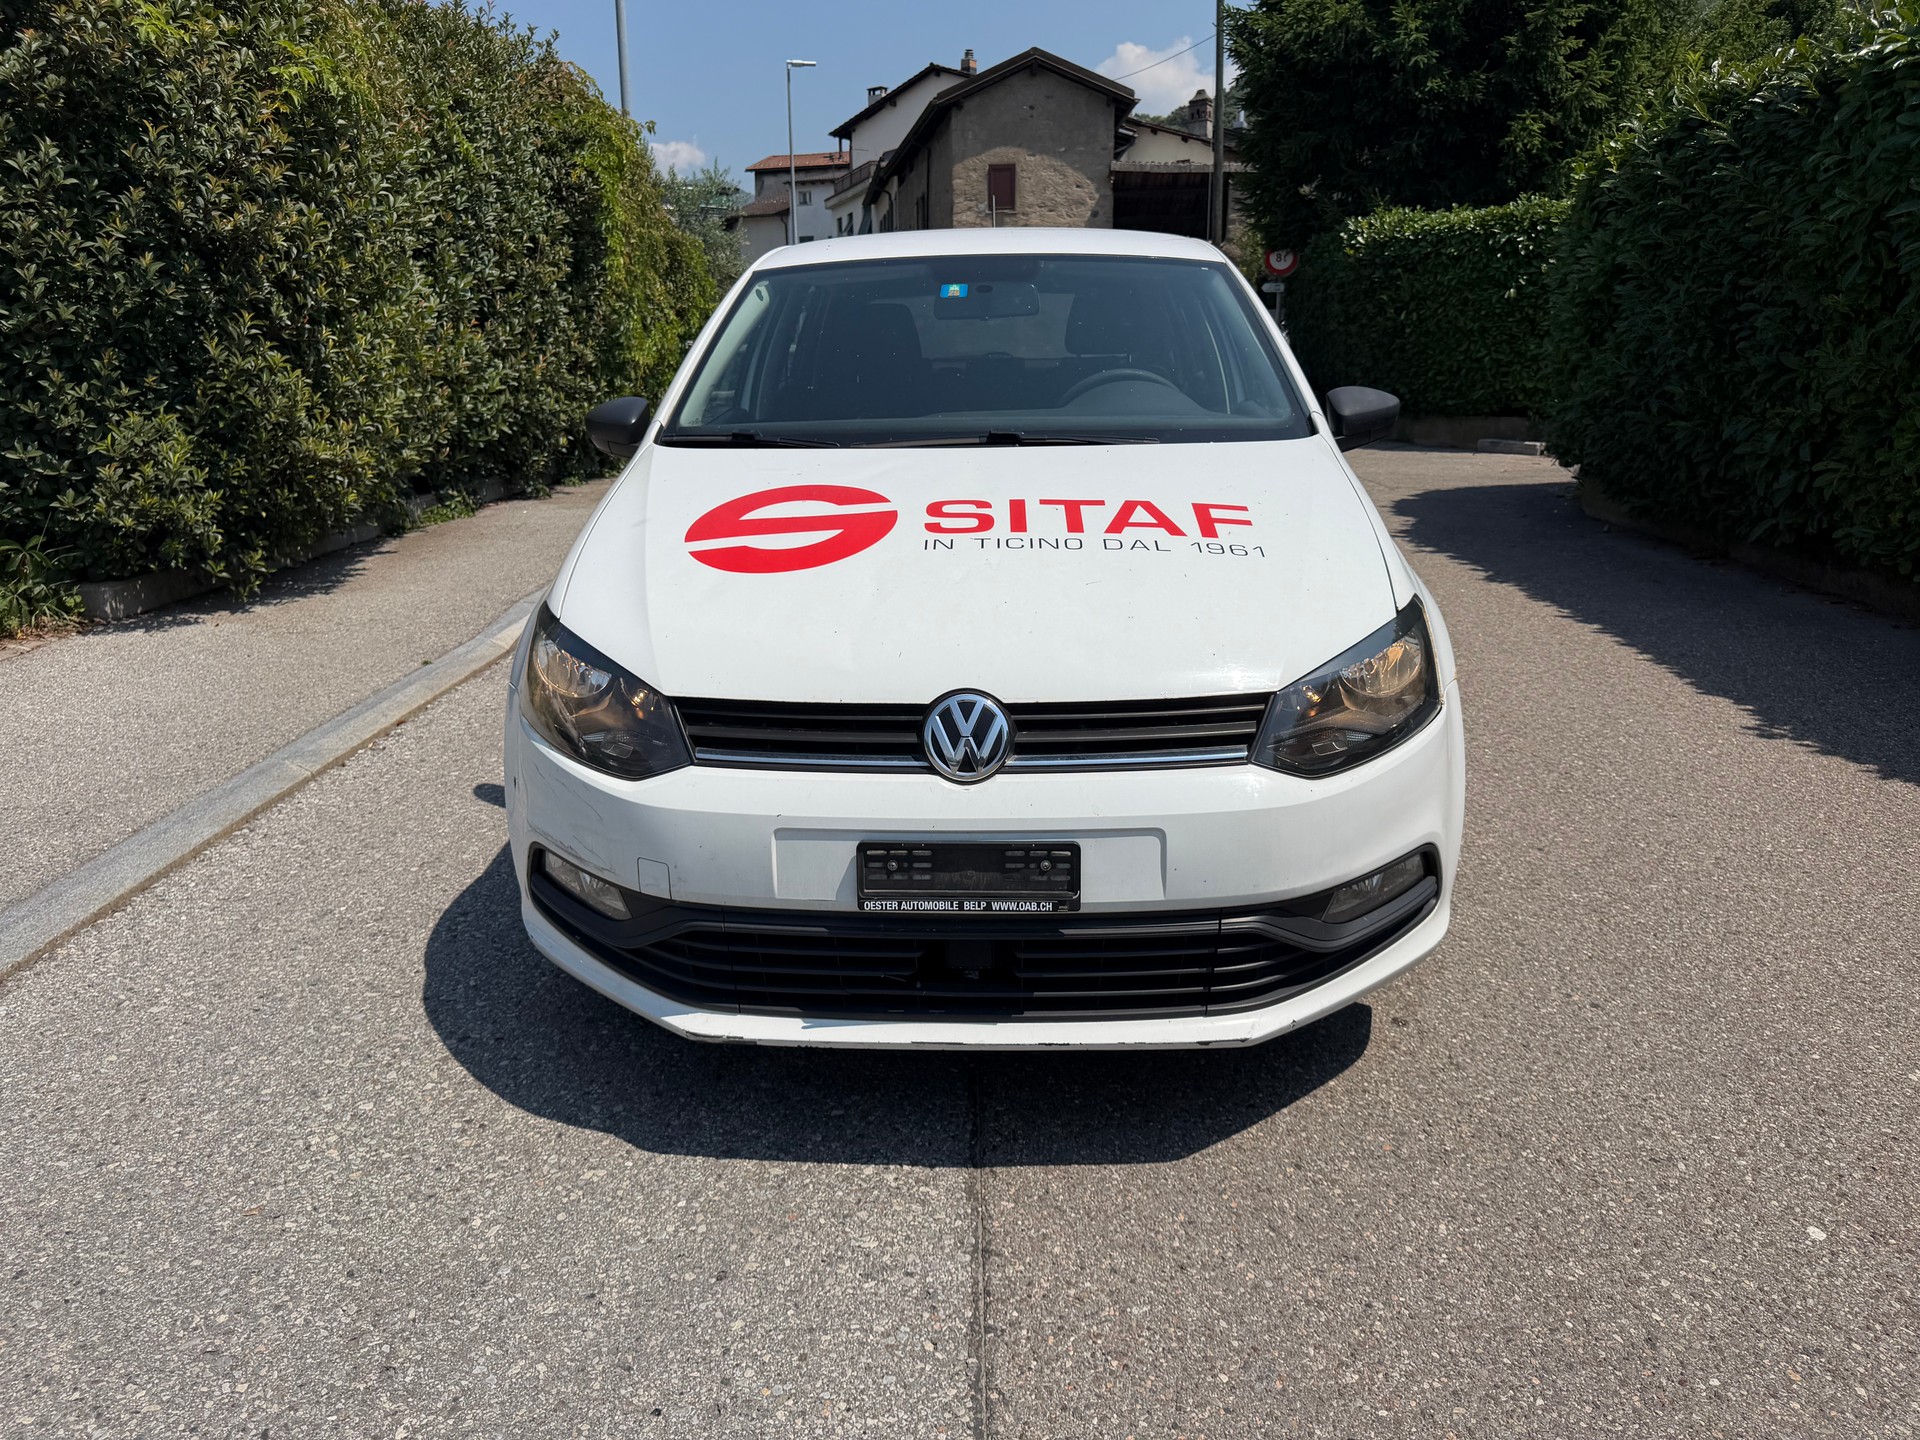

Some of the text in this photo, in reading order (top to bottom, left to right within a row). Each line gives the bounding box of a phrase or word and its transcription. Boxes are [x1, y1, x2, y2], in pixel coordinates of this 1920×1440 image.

[924, 499, 1253, 538] SITAF
[924, 537, 1266, 558] IN TICINO DAL 1961
[924, 693, 1009, 782] VW
[863, 901, 1053, 912] OESTER AUTOMOBILE BELP WWW.OAB.CH
